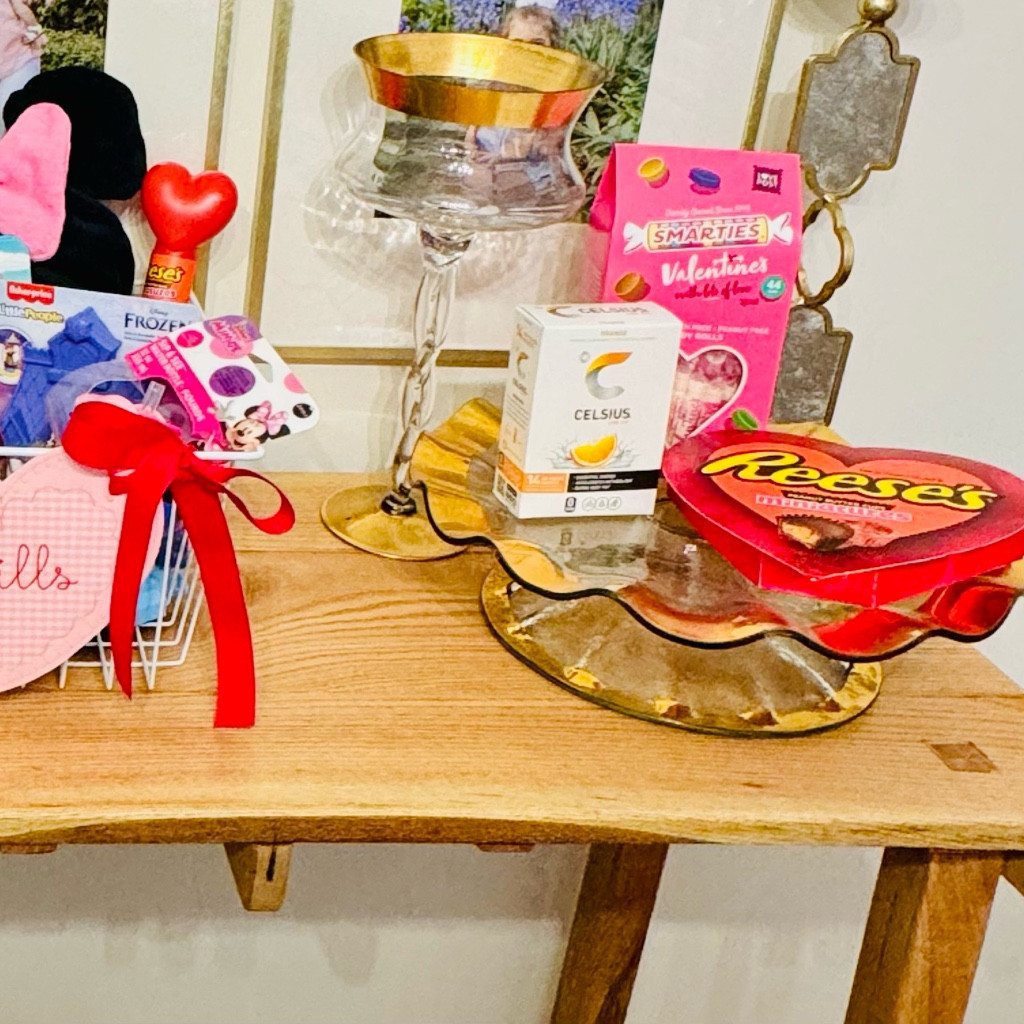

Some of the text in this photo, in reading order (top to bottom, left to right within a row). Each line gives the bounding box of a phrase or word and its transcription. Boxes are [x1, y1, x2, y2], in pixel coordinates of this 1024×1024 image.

[653, 223, 760, 243] SMARTIES
[149, 265, 184, 282] ese's
[574, 407, 631, 420] CELSIUS
[700, 451, 998, 511] Reese's
[755, 494, 913, 523] miniatures
